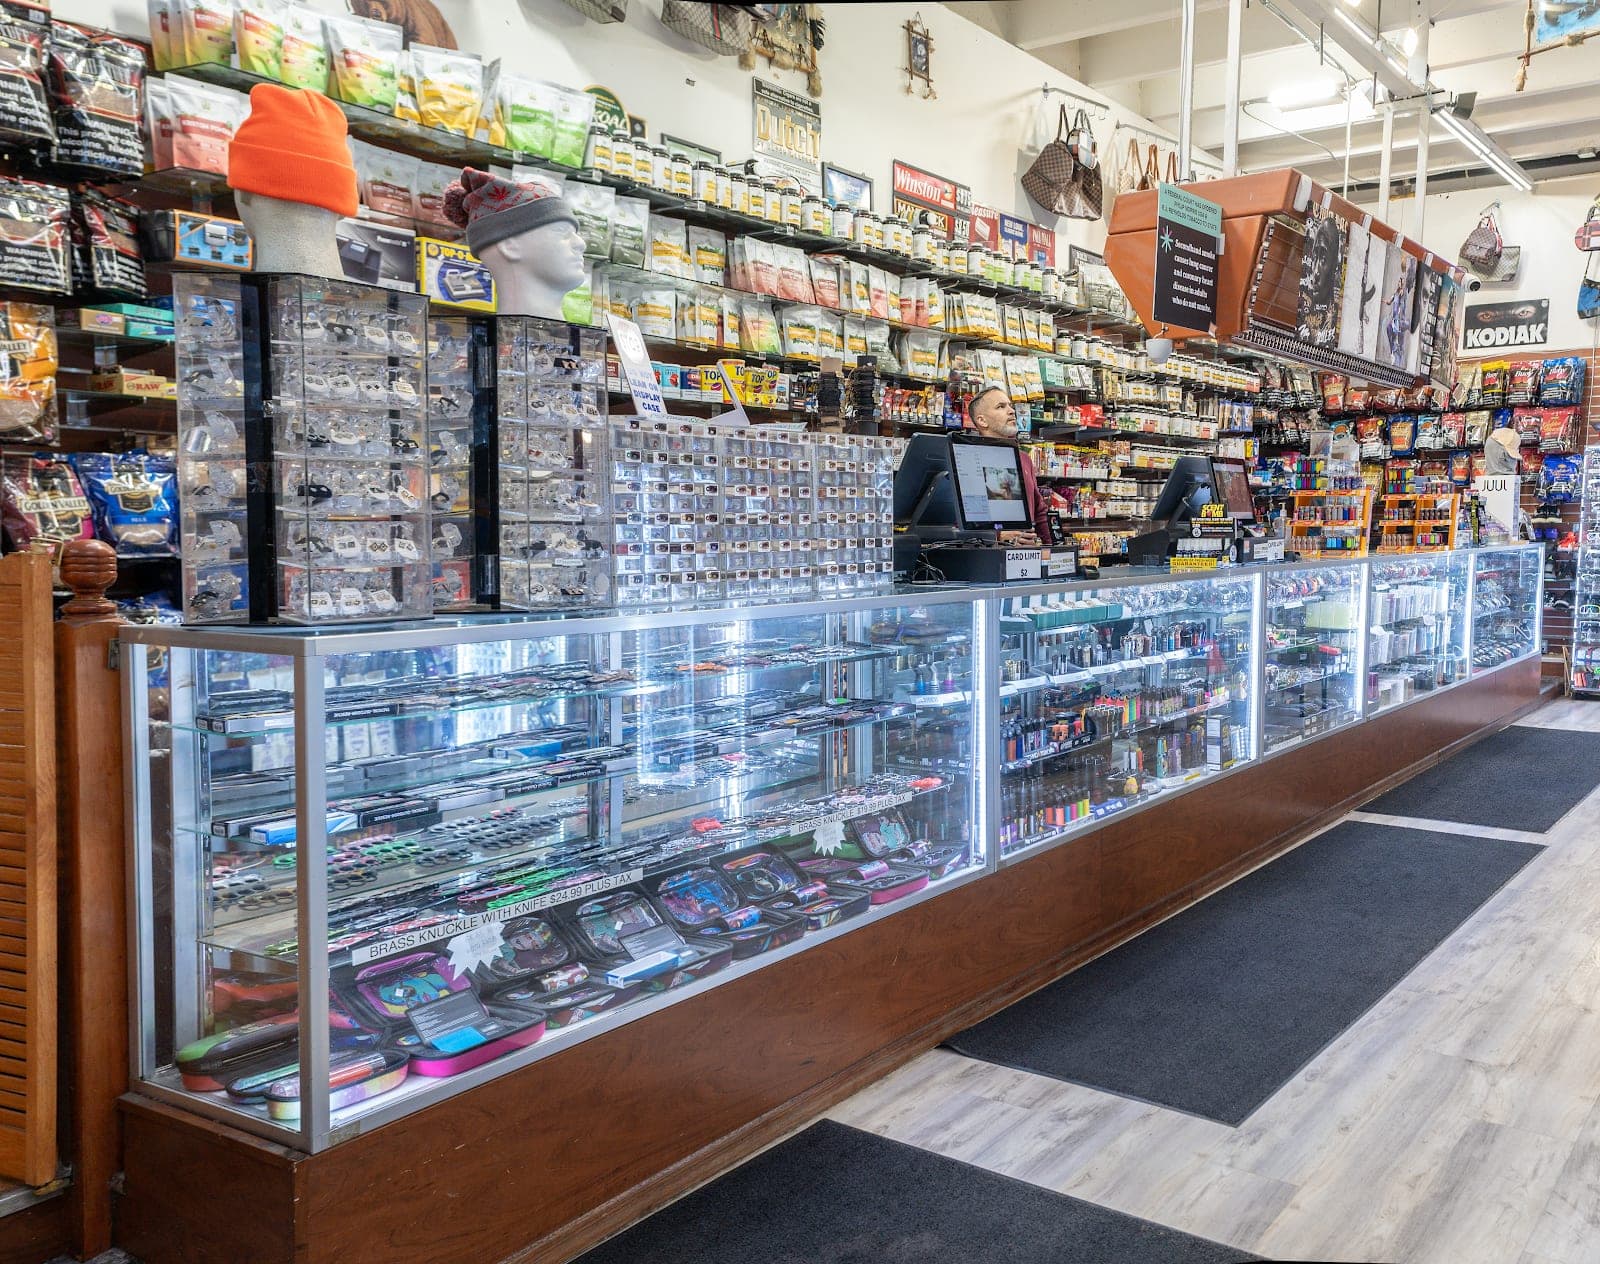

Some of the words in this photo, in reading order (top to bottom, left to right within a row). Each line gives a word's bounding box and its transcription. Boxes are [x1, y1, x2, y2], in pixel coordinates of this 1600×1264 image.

[757, 104, 820, 158] Dutch
[896, 167, 940, 202] Winston
[1175, 239, 1202, 255] Secondhand
[1189, 257, 1199, 270] lung
[1174, 269, 1182, 277] and
[1183, 272, 1201, 284] coronary
[1202, 275, 1213, 286] heart
[1467, 323, 1545, 347] KODIAK
[704, 370, 721, 381] TOP
[736, 366, 744, 376] TO
[767, 370, 777, 379] OP
[752, 374, 765, 384] TOP
[634, 389, 660, 402] DISPLAY
[642, 402, 661, 412] CASE
[1007, 553, 1023, 561] CARD
[1025, 552, 1040, 560] LIMIT
[1021, 568, 1028, 577] $2
[798, 820, 823, 832] BRASS
[823, 811, 854, 825] KNUCKLE
[857, 802, 877, 815] $19.99
[877, 797, 893, 809] PLUS
[894, 794, 906, 805] TAX
[369, 935, 415, 958] BRASS
[419, 916, 478, 945] KNUCKLE
[481, 907, 511, 923] WITH
[514, 896, 548, 916] KNIFE
[549, 886, 583, 908] $24.99
[584, 878, 611, 897] PLUS
[613, 872, 633, 890] TAX
